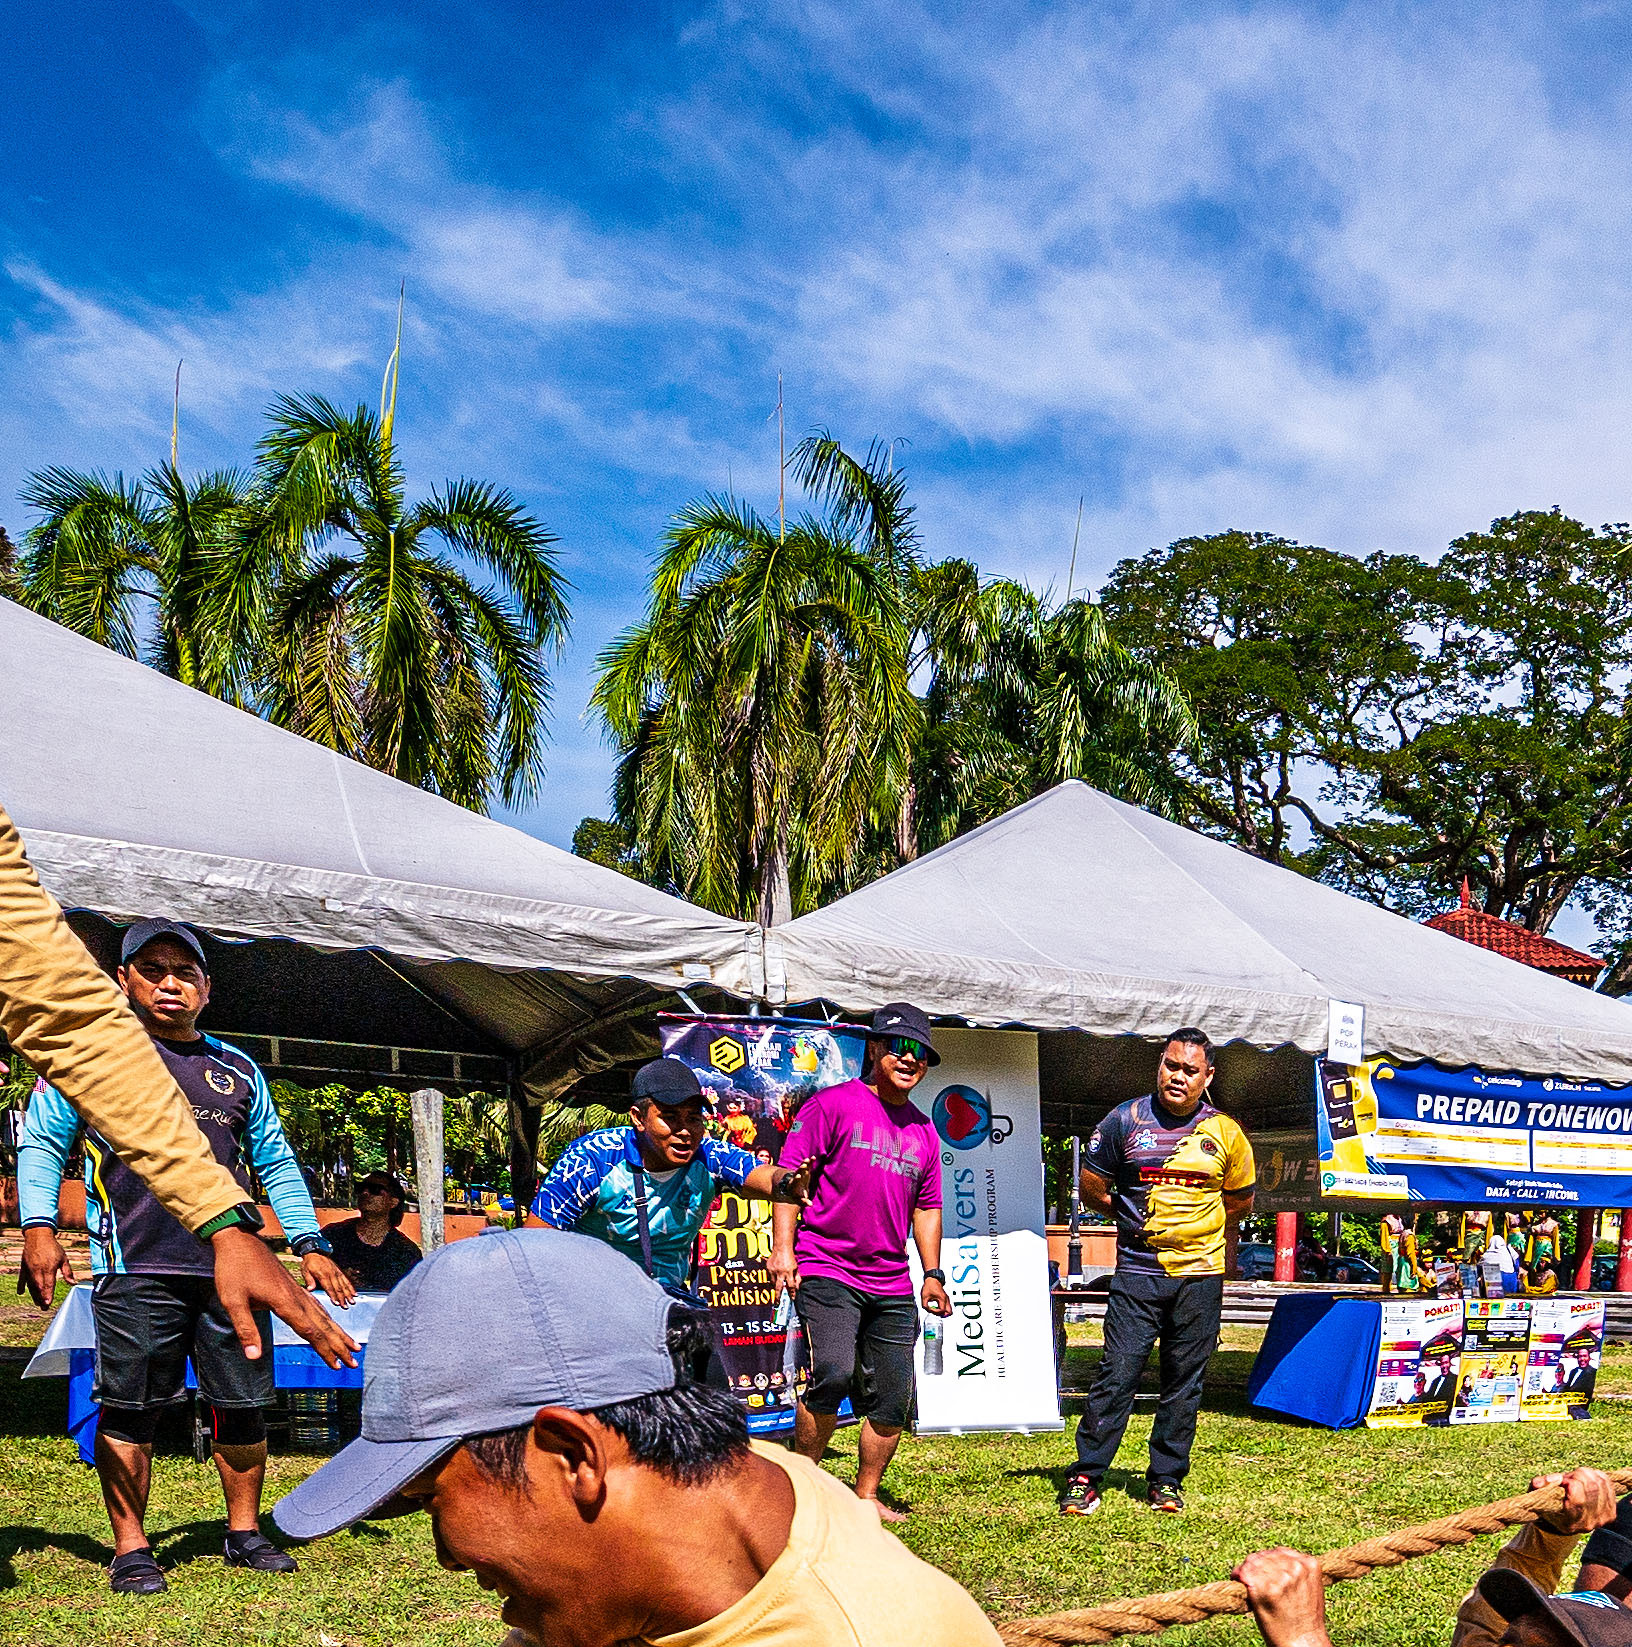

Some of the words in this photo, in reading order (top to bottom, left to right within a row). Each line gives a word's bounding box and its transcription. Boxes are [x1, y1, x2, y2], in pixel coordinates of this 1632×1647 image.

[1416, 1093, 1522, 1126] PREPAID
[985, 1168, 998, 1226] PROGRAM
[1485, 1186, 1510, 1198] DATA
[1516, 1188, 1539, 1199] CALL
[951, 1167, 987, 1379] MediSavers
[988, 1228, 1002, 1302] MEMBERSHIP
[721, 1322, 735, 1335] 13
[745, 1321, 760, 1334] 15
